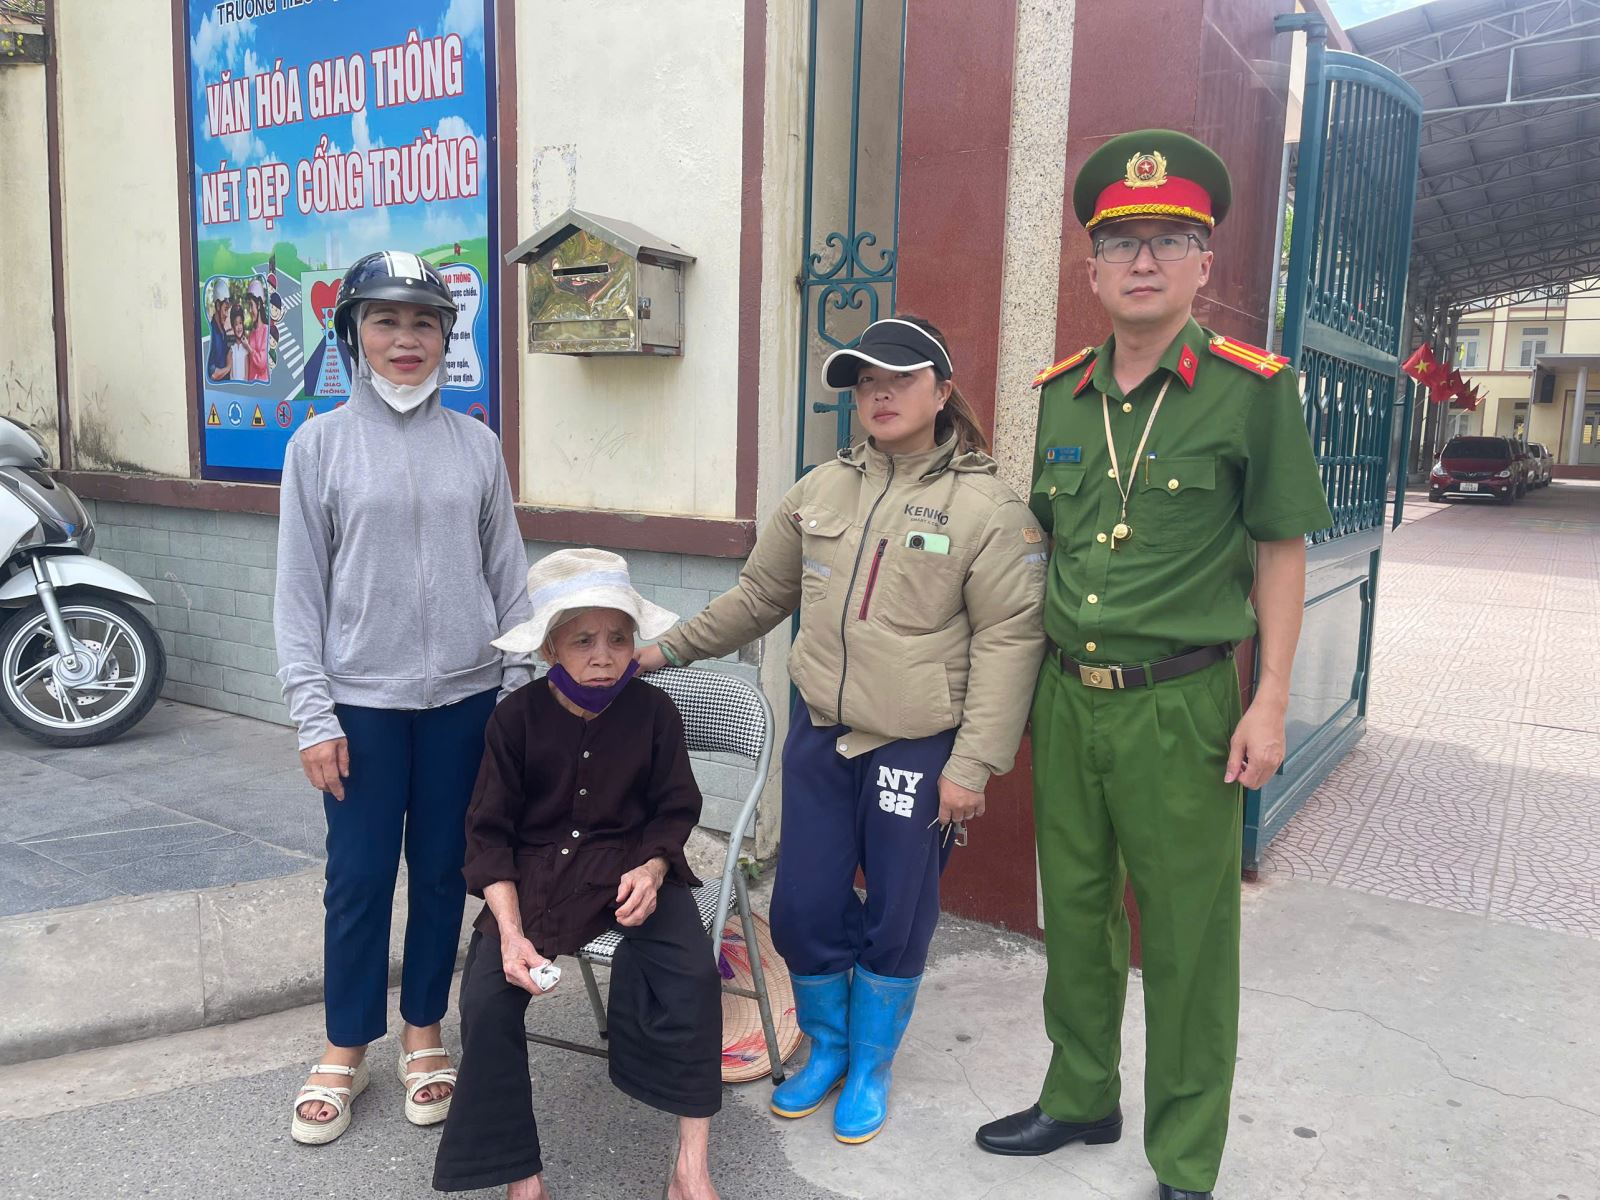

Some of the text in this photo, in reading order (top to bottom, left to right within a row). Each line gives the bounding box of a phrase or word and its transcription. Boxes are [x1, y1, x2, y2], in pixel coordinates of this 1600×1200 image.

[206, 29, 463, 137] VĂN HÓA GIAO THÔNG
[202, 127, 479, 229] NÉT ĐẸP CỔNG TRƯỜNG
[904, 503, 949, 526] KENKO
[876, 765, 924, 794] NY
[878, 789, 915, 818] 82
